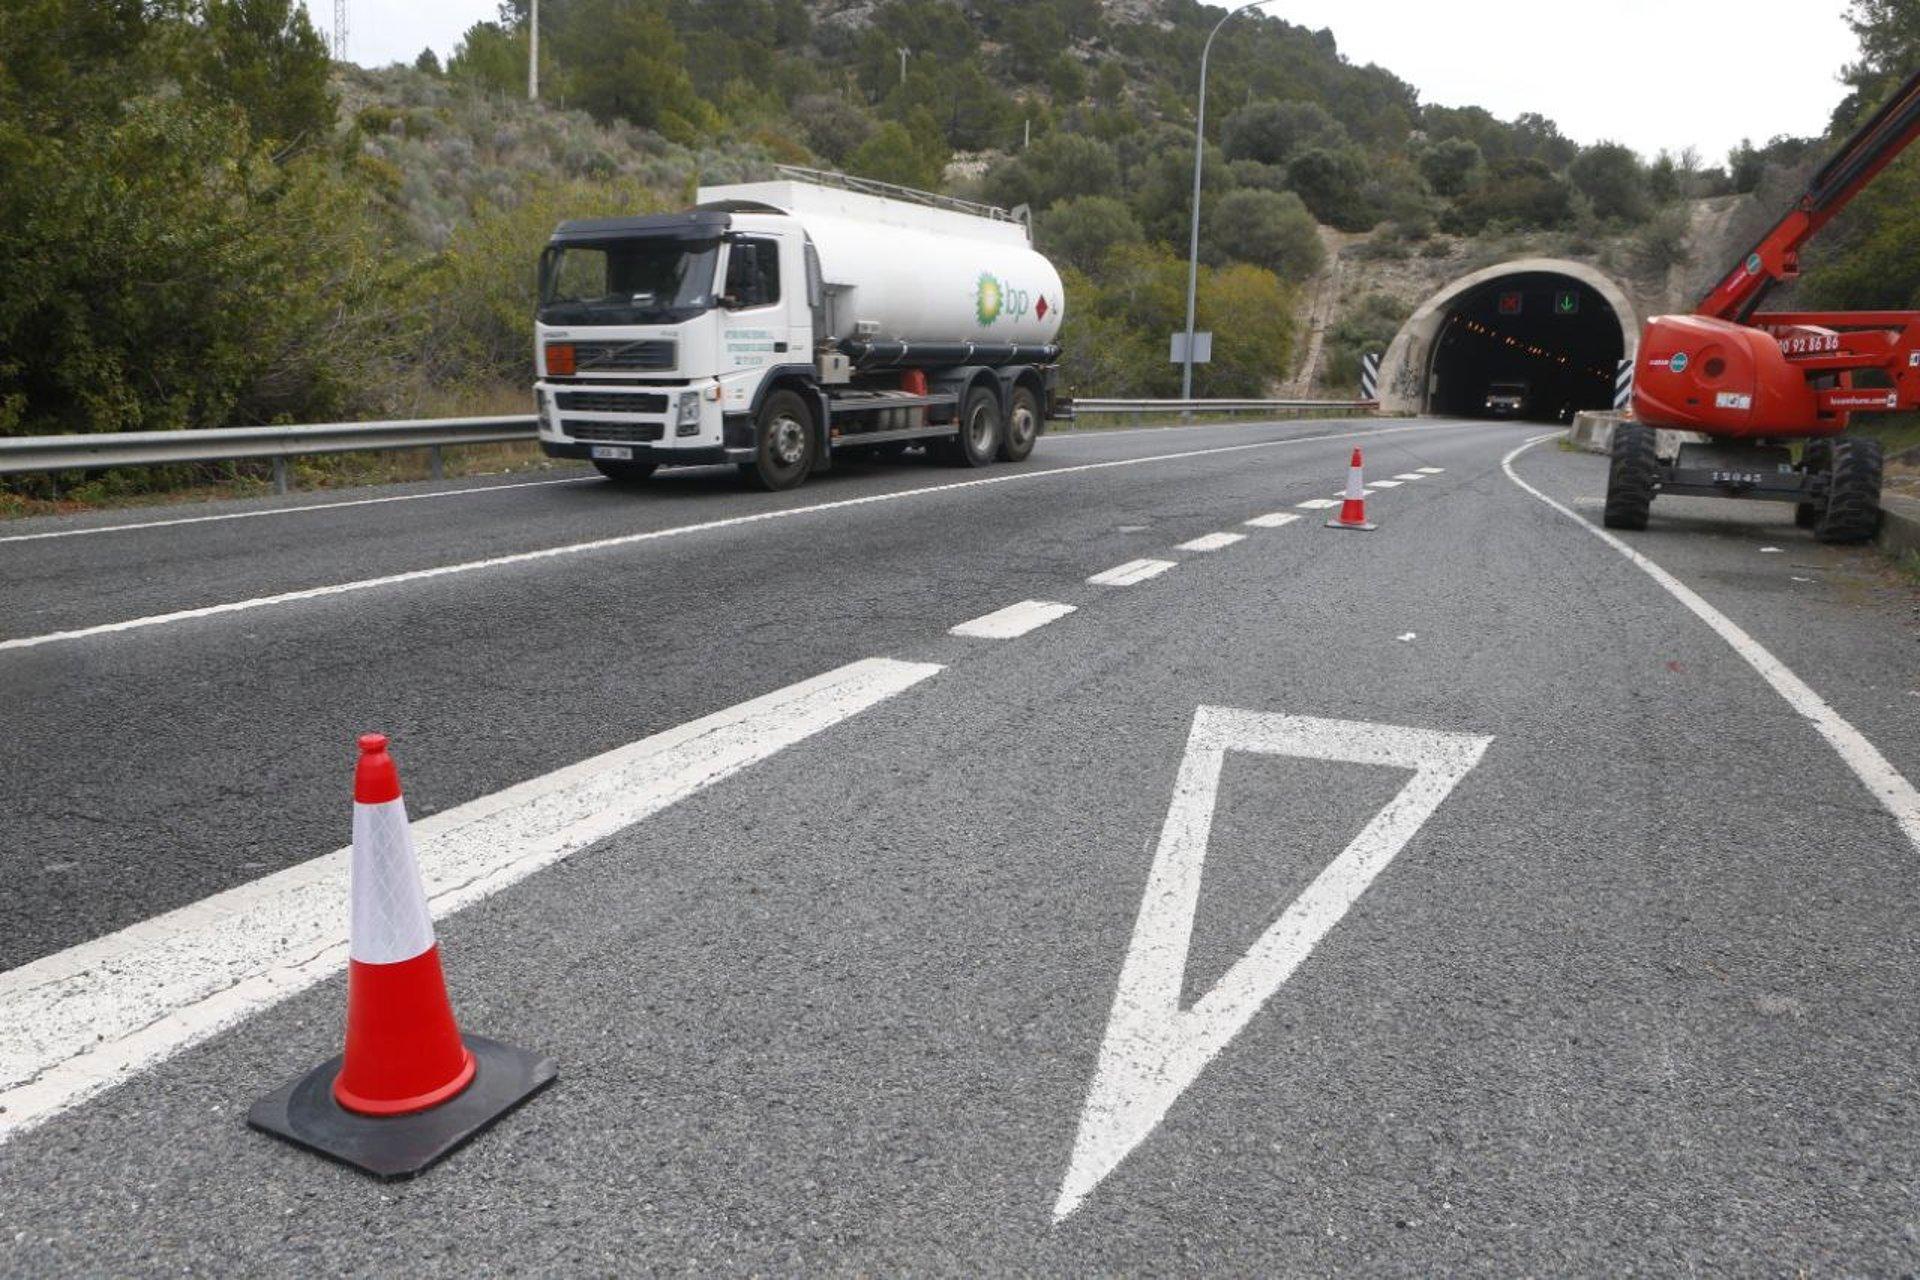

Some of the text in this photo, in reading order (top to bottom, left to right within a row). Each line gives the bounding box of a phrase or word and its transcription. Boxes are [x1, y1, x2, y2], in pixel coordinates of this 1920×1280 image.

[1005, 280, 1028, 323] bp
[1793, 338, 1806, 352] 92
[1808, 336, 1822, 351] 86
[1825, 335, 1839, 350] 86
